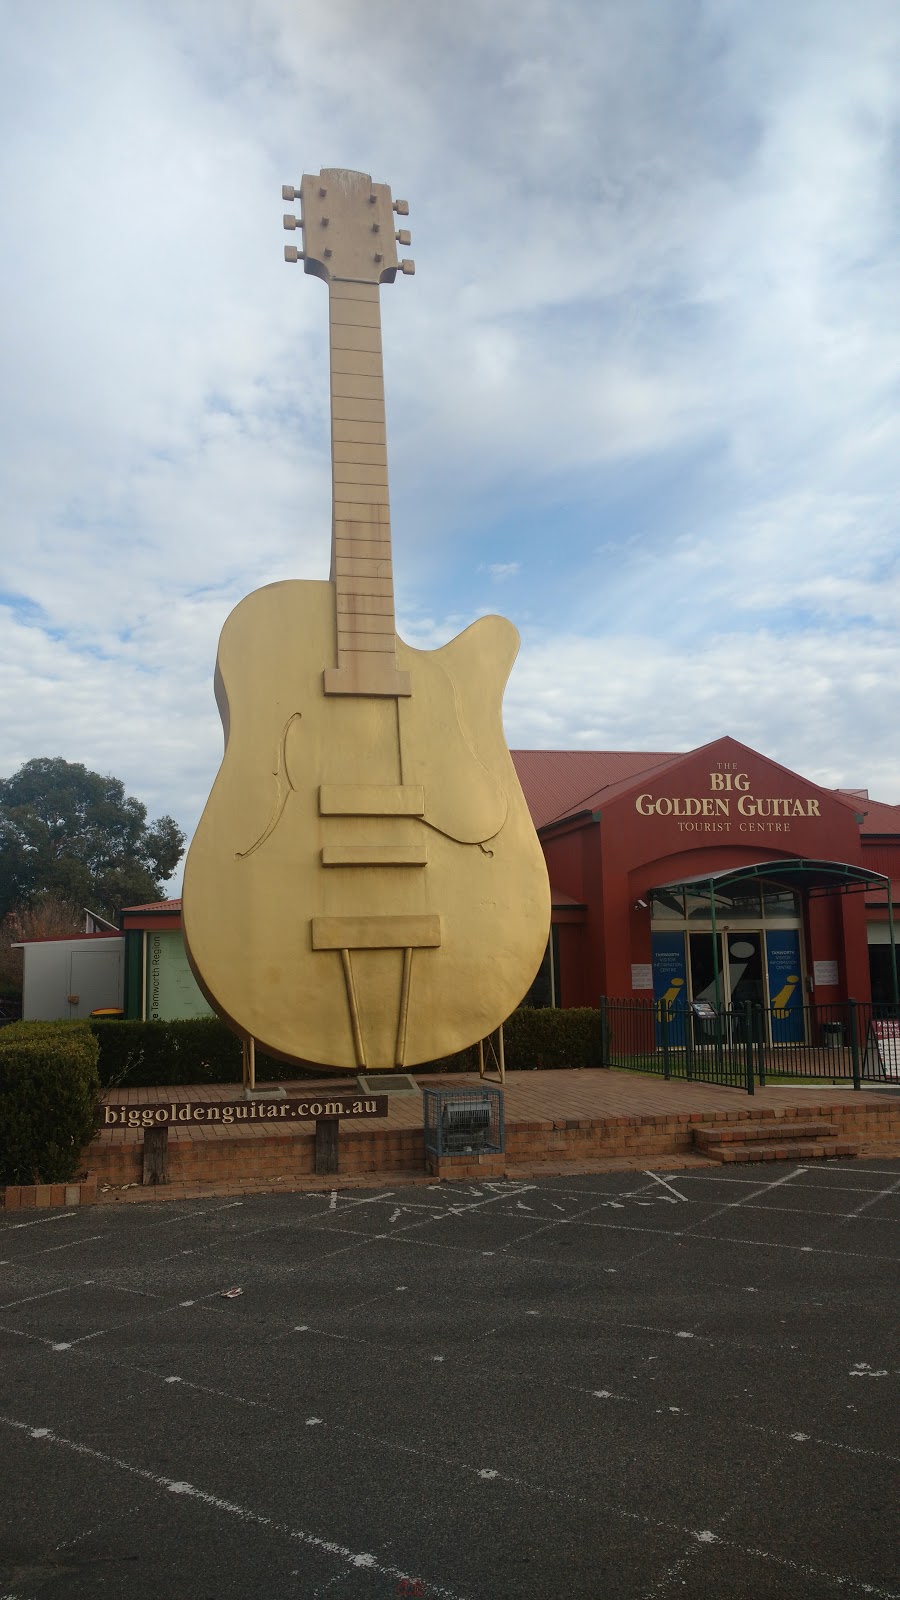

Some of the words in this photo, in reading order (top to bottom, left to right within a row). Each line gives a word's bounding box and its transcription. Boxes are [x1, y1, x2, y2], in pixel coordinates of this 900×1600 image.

[710, 773, 751, 791] BIG
[635, 794, 730, 817] GOLDEN
[737, 795, 821, 817] GUITAR
[678, 822, 732, 832] TOURIST
[739, 822, 791, 832] CENTRE
[152, 936, 161, 966] Region
[151, 967, 160, 1011] Tamworth
[104, 1099, 378, 1127] biggoldenguitar.com.au
